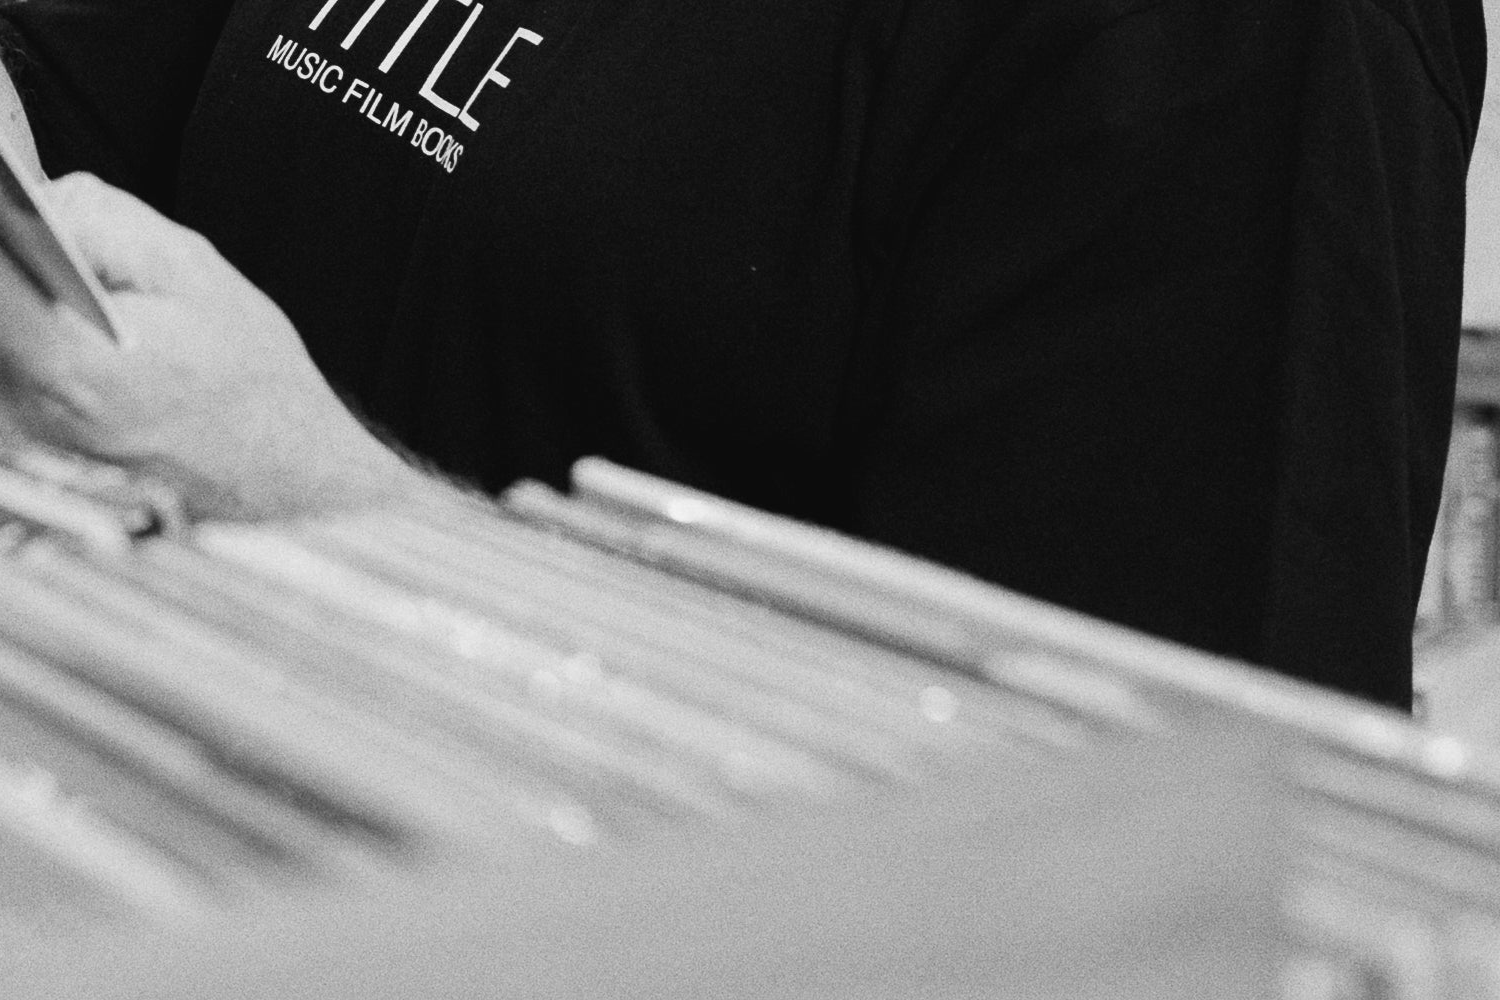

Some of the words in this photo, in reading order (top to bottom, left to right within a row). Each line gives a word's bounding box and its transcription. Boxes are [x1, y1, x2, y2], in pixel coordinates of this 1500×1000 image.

[267, 35, 343, 93] MUSIC
[342, 79, 413, 136] FILM
[411, 119, 463, 173] BOOKS
